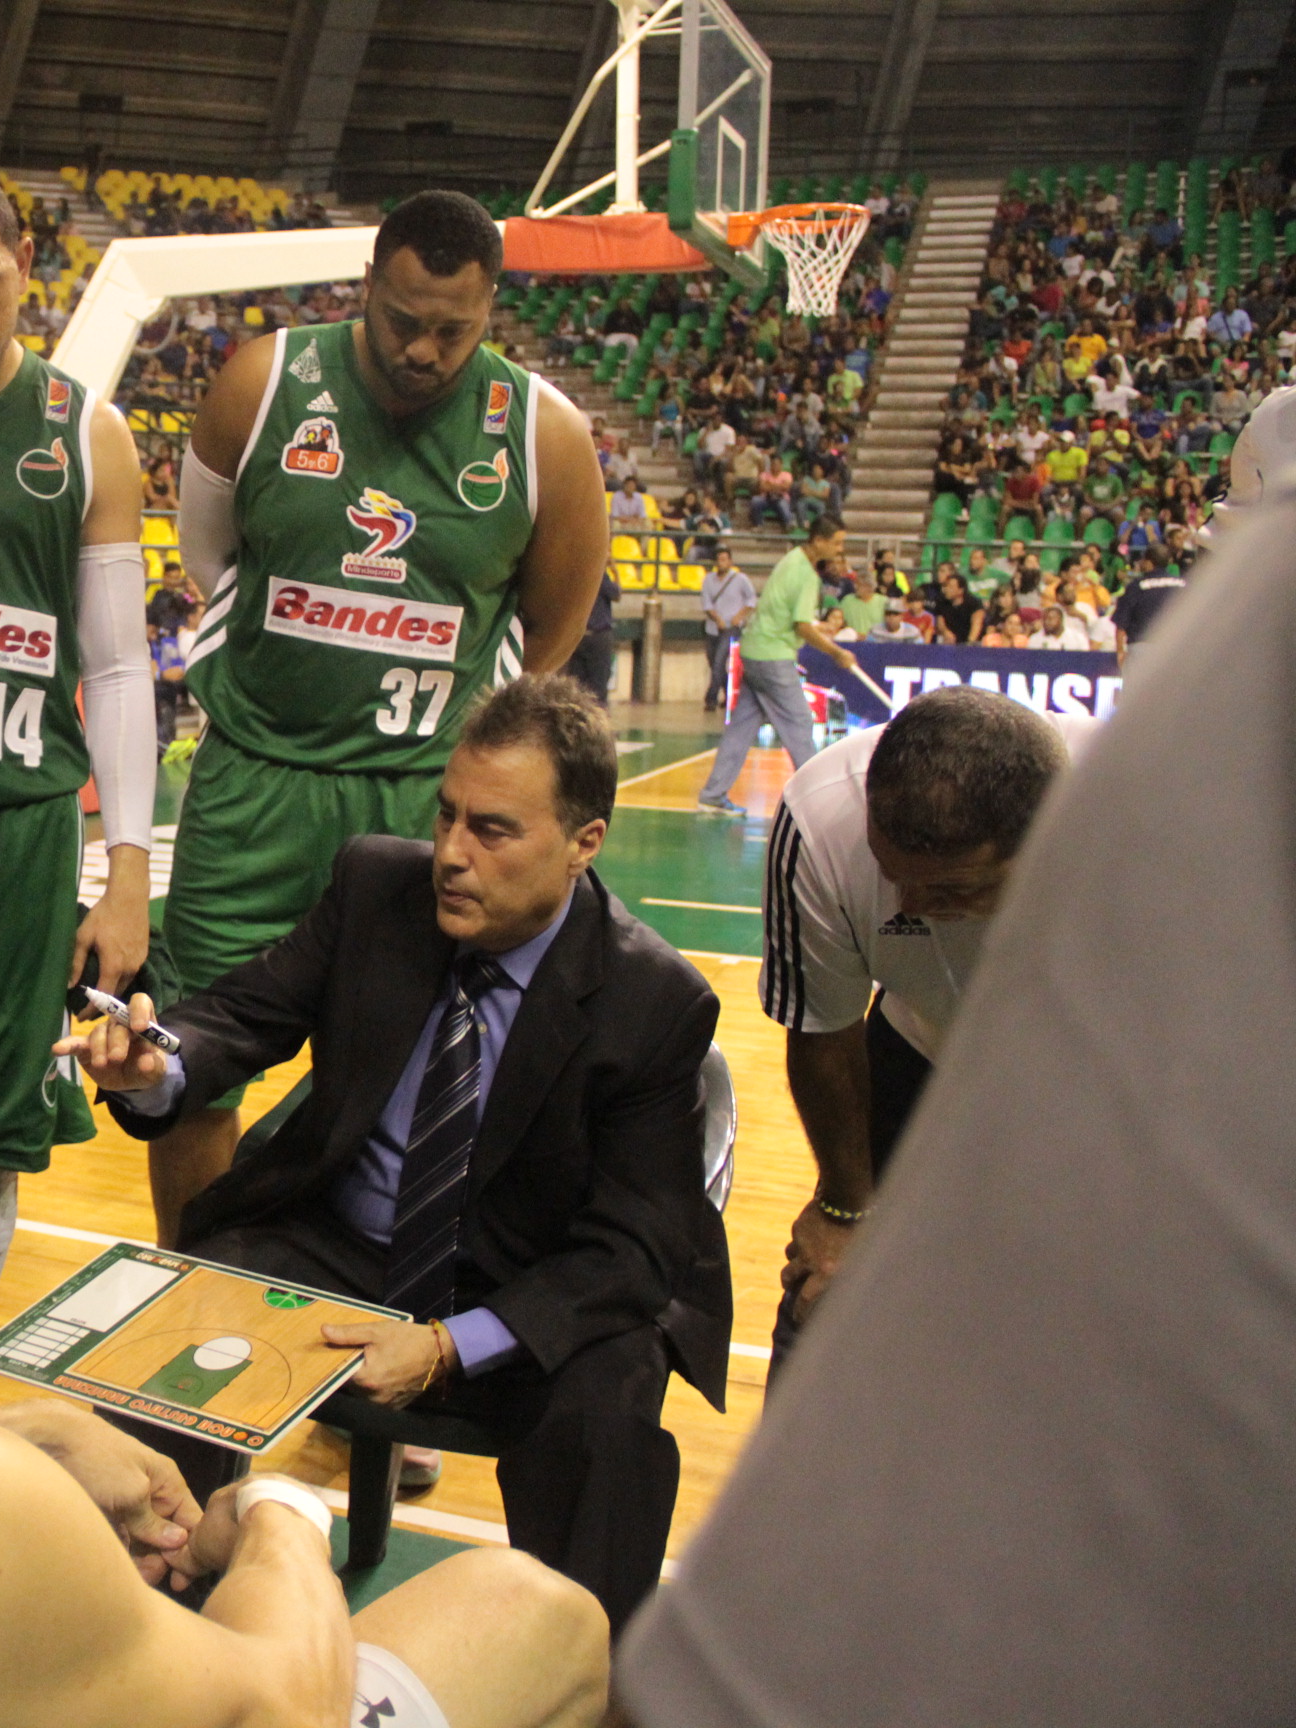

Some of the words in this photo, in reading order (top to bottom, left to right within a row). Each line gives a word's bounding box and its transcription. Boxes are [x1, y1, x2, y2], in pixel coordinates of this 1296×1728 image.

[271, 586, 456, 646] Bandes
[376, 668, 454, 736] 37
[879, 926, 931, 936] adidas
